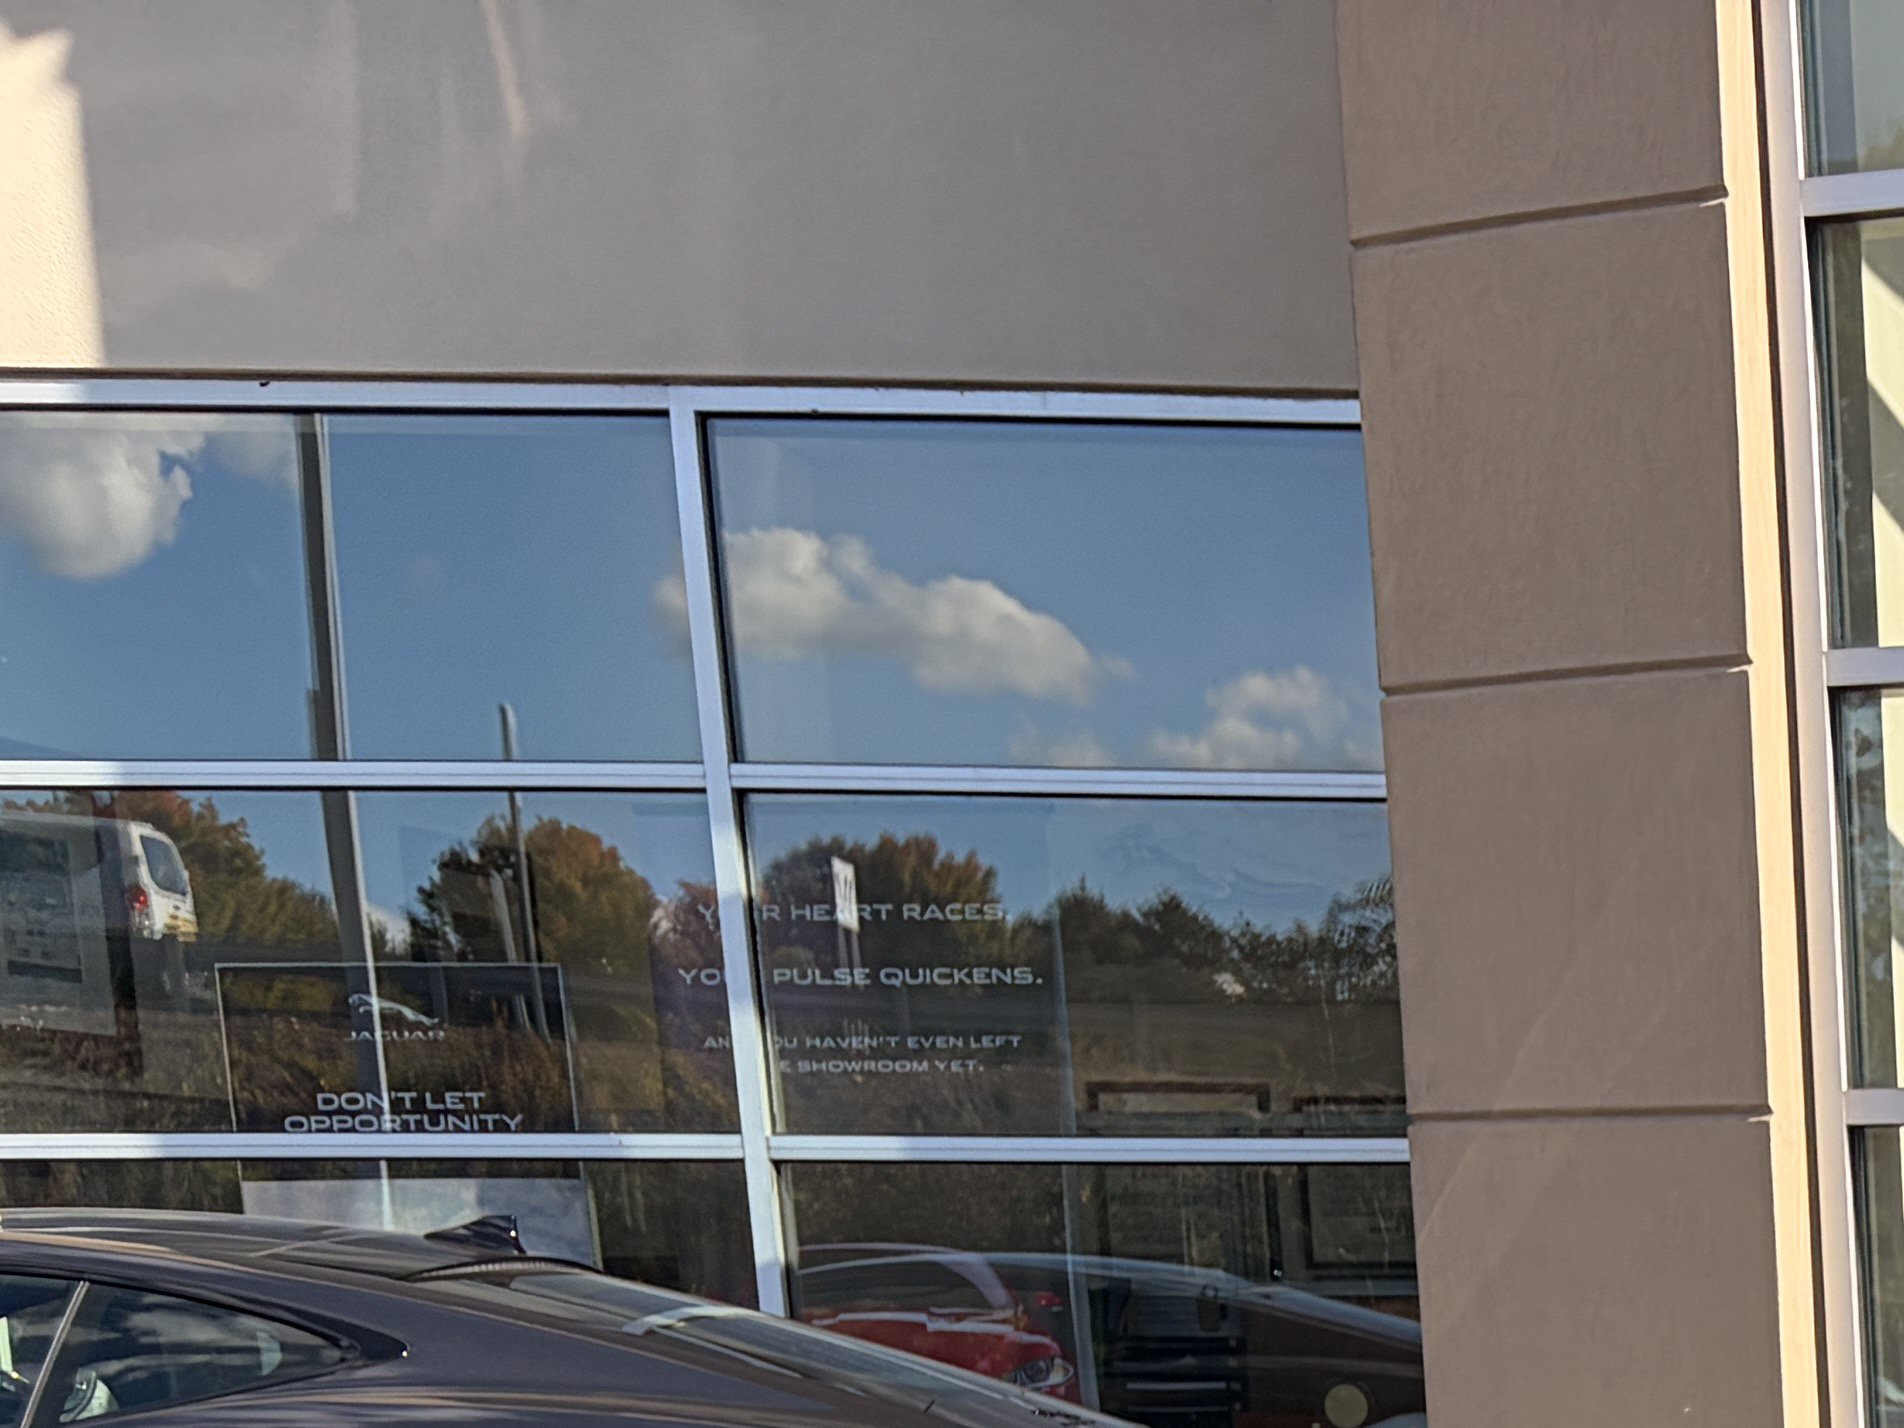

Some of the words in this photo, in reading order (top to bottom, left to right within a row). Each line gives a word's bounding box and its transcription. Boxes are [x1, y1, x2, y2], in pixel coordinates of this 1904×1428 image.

[697, 903, 780, 921] YR
[791, 903, 893, 921] HEART
[902, 903, 1012, 921] RACES.
[773, 967, 871, 986] PULSE
[879, 967, 1044, 987] QUICKENS.
[805, 1035, 899, 1048] HAVEN'T
[907, 1035, 964, 1048] EVEN
[970, 1035, 1022, 1048] LEFT
[797, 1059, 929, 1073] SHOWROOM
[935, 1059, 985, 1073] YET.
[317, 1091, 418, 1111] DON'T
[425, 1091, 486, 1110] LET
[284, 1114, 524, 1132] OPPORTUNITY
